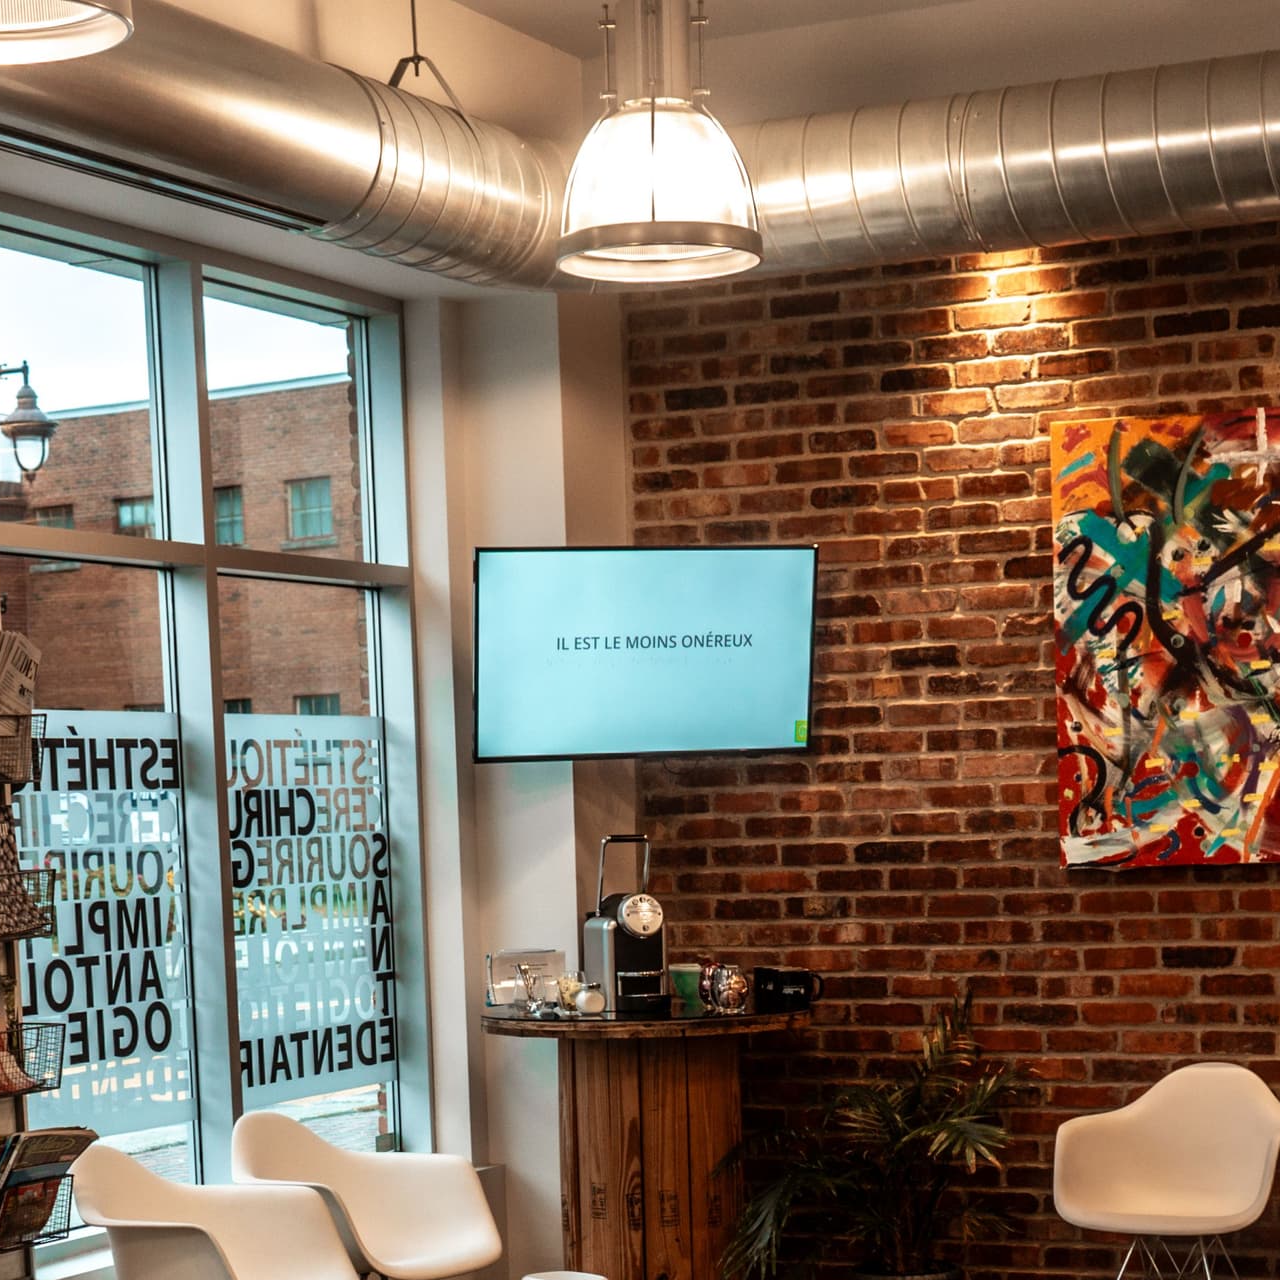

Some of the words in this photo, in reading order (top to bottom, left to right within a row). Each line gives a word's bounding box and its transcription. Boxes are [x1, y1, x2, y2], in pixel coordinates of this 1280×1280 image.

[556, 636, 570, 651] IL
[574, 636, 600, 651] EST
[604, 635, 621, 650] LE
[625, 635, 677, 649] MOINS
[681, 631, 753, 648] ONÉREUX
